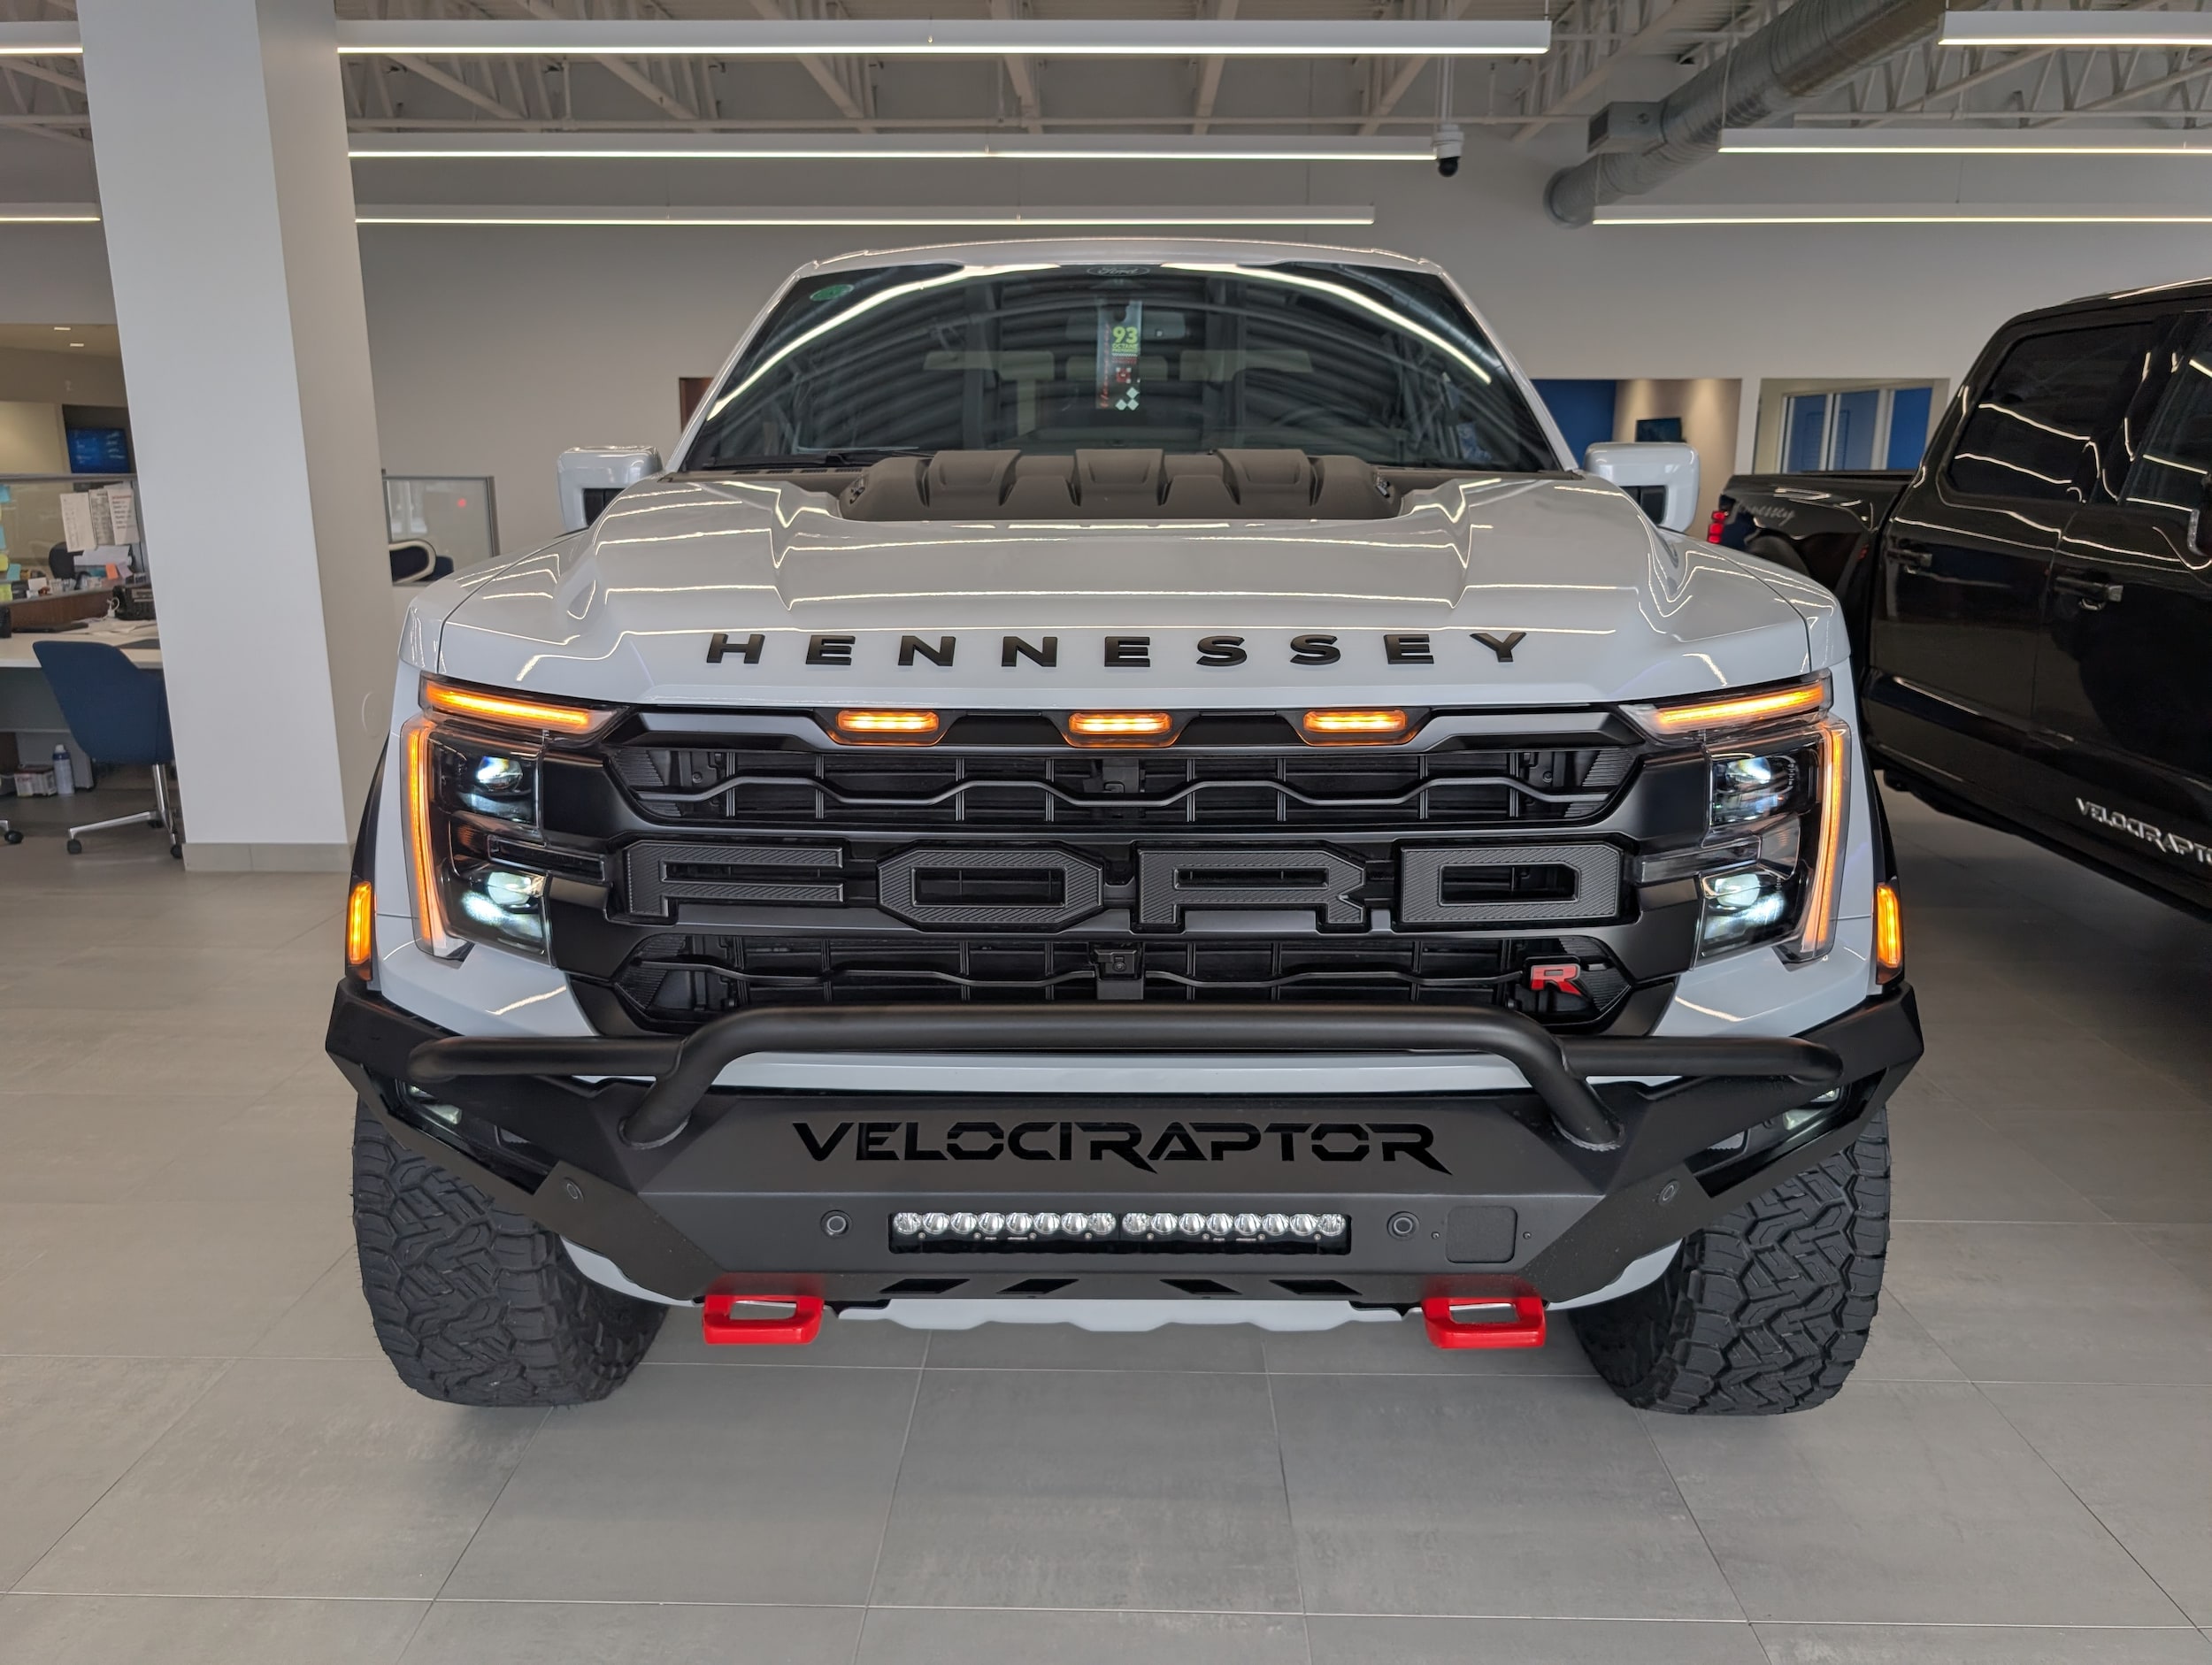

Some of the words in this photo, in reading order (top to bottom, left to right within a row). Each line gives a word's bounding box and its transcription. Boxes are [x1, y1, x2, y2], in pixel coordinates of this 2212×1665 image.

[1112, 326, 1139, 344] 93
[706, 632, 1527, 667] HENNESSEY
[626, 840, 1623, 925] FORD
[1530, 963, 1582, 996] R
[792, 1121, 1454, 1176] VELOCIRAPTOR
